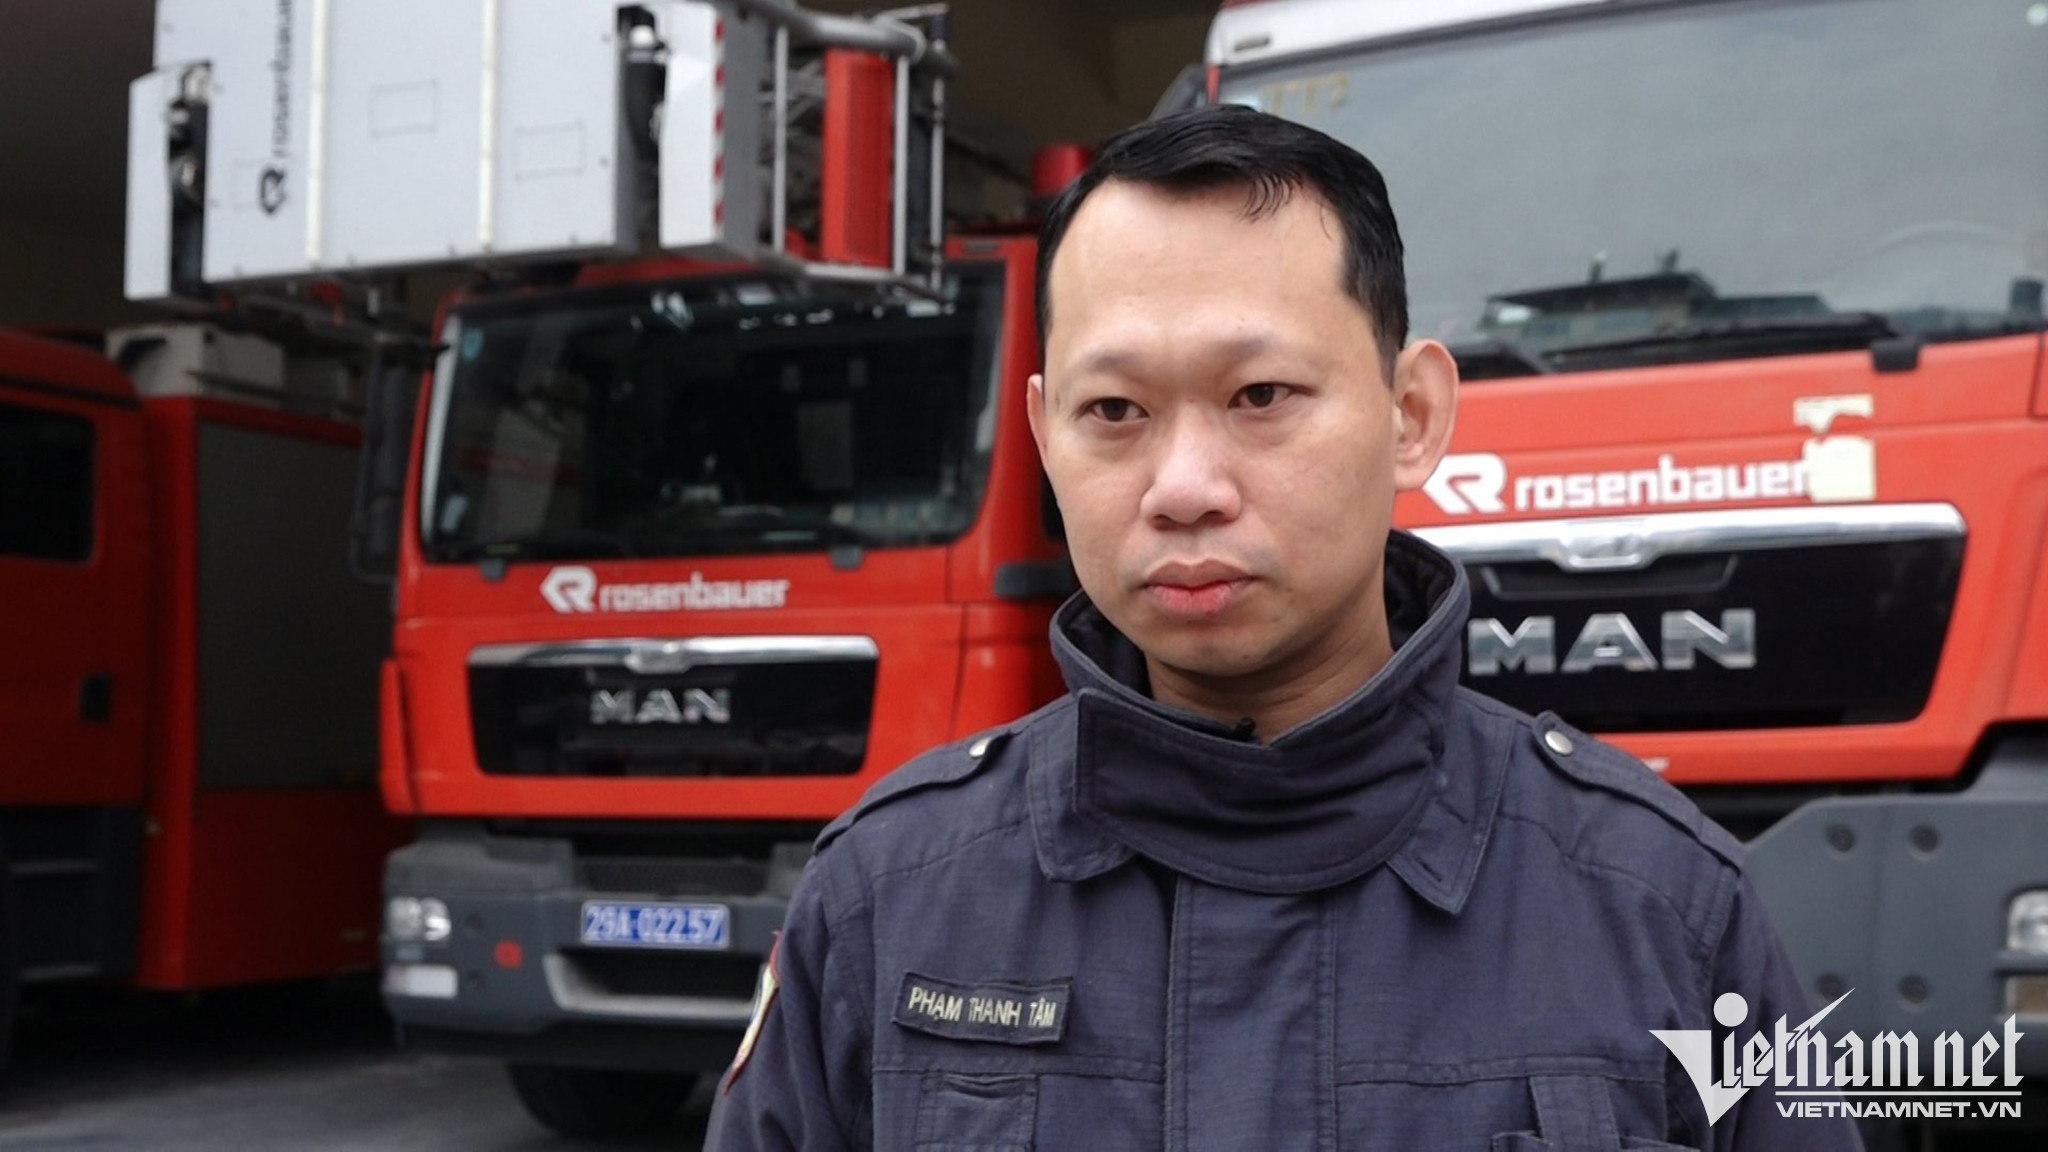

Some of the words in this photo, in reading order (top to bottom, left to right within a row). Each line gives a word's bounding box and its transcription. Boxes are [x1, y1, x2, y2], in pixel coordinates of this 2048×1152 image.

[600, 571, 791, 612] rosenbauer
[1468, 608, 1757, 676] MAN
[590, 687, 731, 725] MAN
[908, 986, 964, 1021] PHẠM
[967, 996, 1023, 1027] THANH
[1028, 997, 1057, 1027] TÂM
